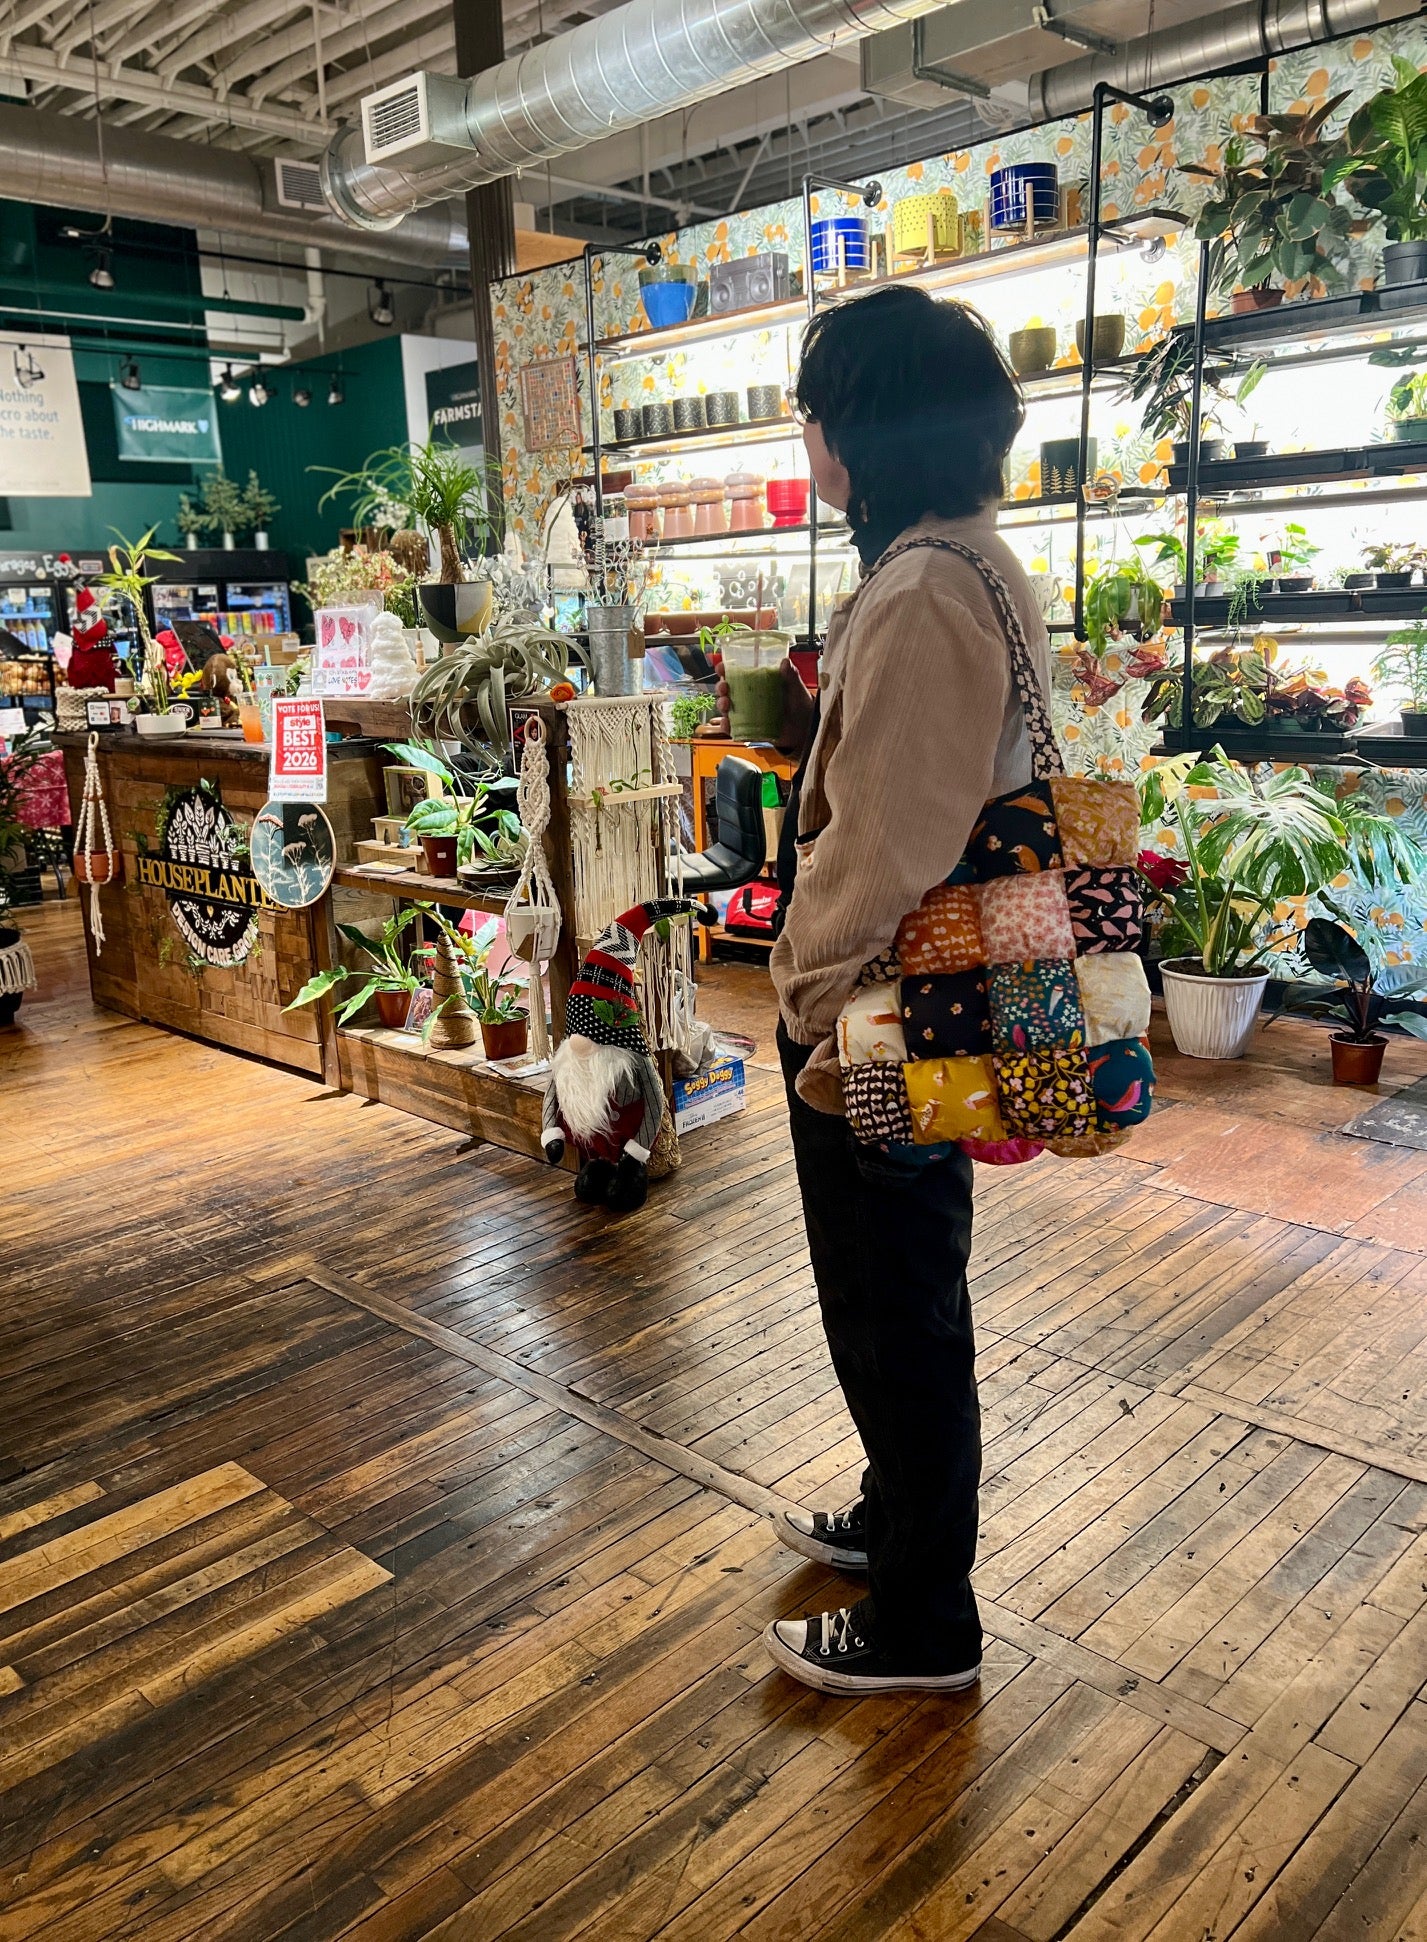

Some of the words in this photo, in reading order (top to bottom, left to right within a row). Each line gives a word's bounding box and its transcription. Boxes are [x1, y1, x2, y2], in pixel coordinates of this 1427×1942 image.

[25, 409, 59, 423] about
[19, 427, 55, 440] taste.
[277, 704, 296, 714] VOTE
[297, 704, 310, 713] FOR
[289, 717, 311, 729] style
[283, 730, 317, 747] BEST
[283, 751, 318, 767] 2026
[171, 900, 207, 958] DESIGN
[206, 945, 233, 965] CARE
[684, 1076, 709, 1096] Soggy
[709, 1067, 733, 1084] Doggy
